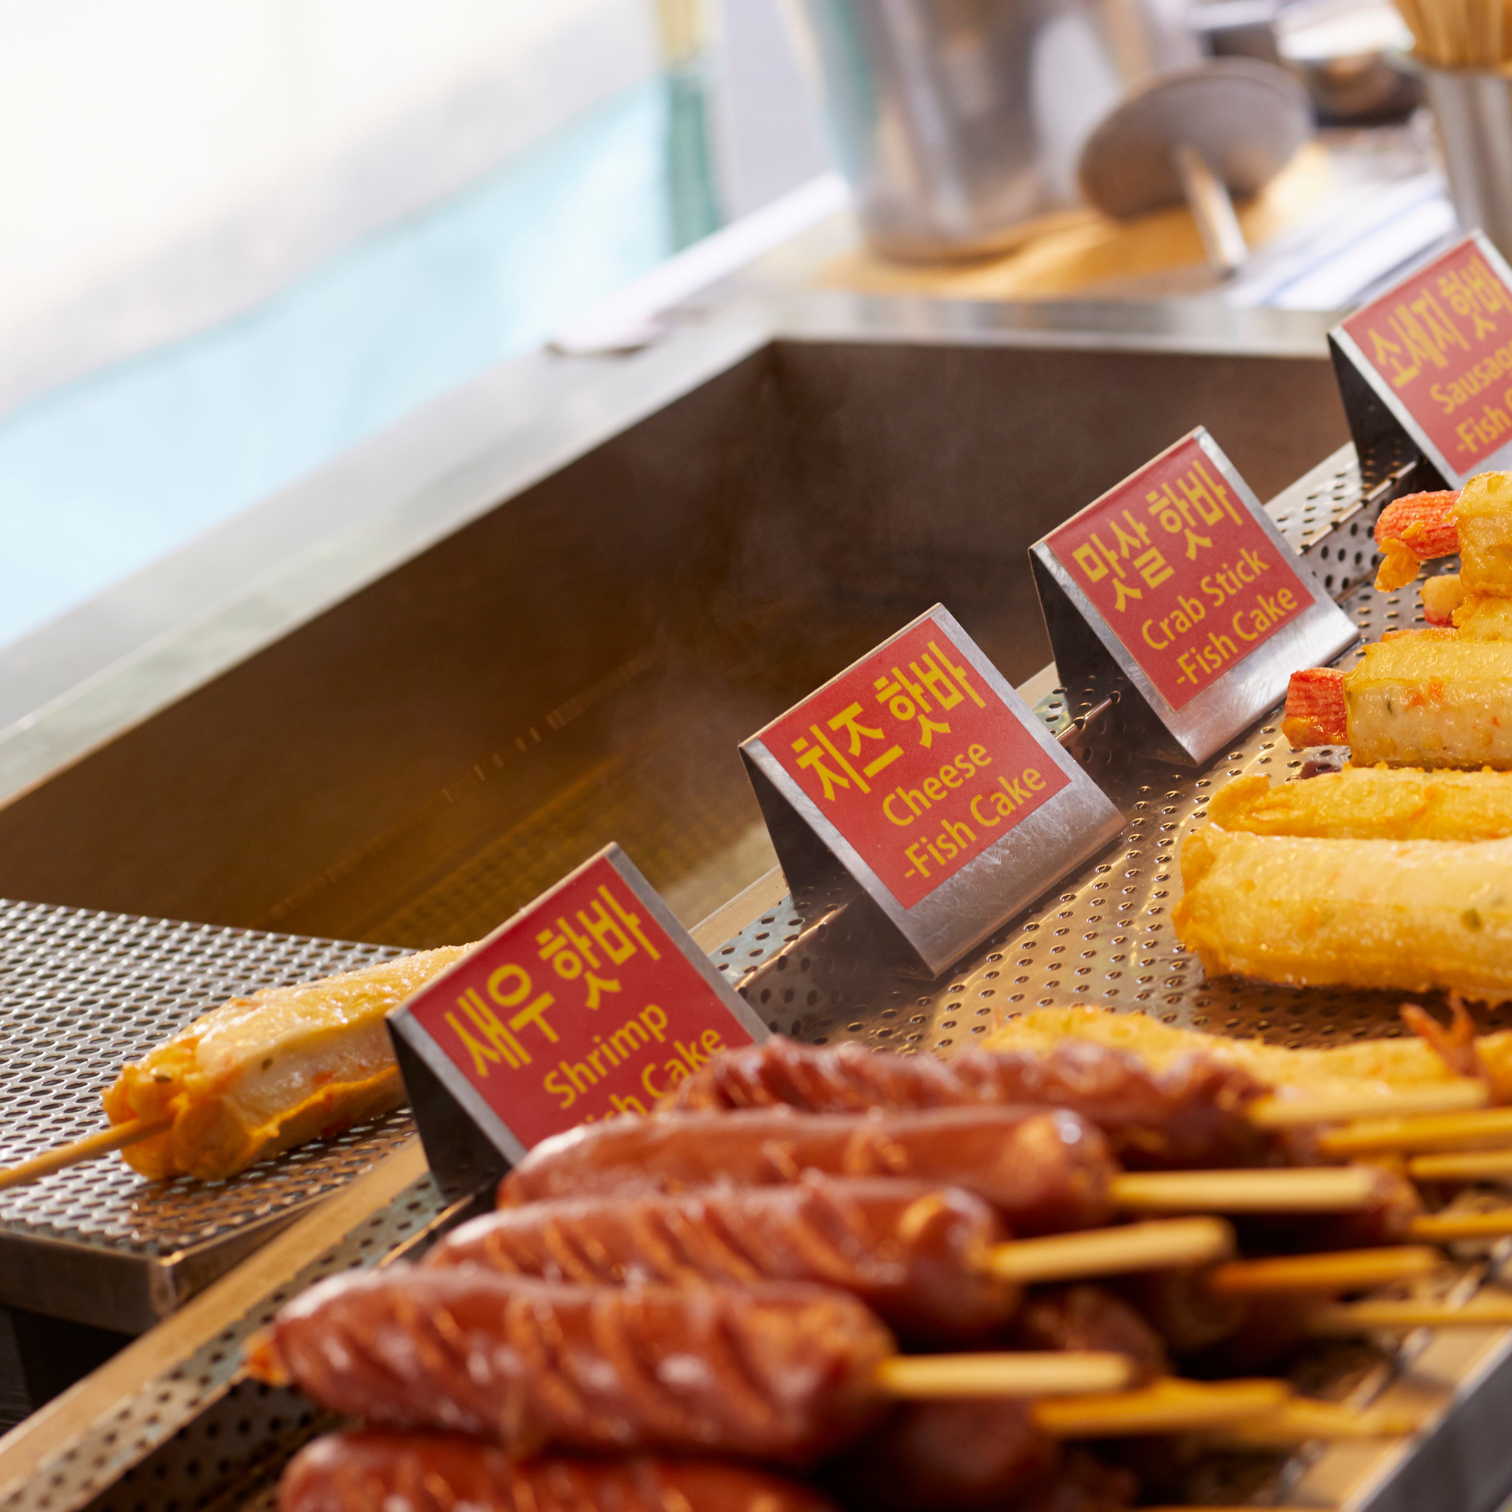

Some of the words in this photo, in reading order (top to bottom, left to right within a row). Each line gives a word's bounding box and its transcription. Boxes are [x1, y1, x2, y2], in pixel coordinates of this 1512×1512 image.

[1368, 288, 1470, 388] 소세지
[1071, 509, 1175, 612] 맛살
[1145, 460, 1243, 561] 핫바
[1141, 595, 1206, 650] Crab
[1201, 548, 1270, 607] Stick
[1176, 632, 1239, 685] -Fish
[1232, 587, 1298, 641] Cake
[790, 701, 905, 802] 치즈
[872, 640, 987, 749] 핫바
[882, 743, 993, 827] Cheese
[904, 818, 978, 879] -Fish
[969, 767, 1047, 828] Cake
[444, 963, 560, 1078] 새우
[535, 885, 661, 1011] 핫바
[543, 1004, 669, 1109] Shrimp
[641, 1029, 727, 1099] Cake
